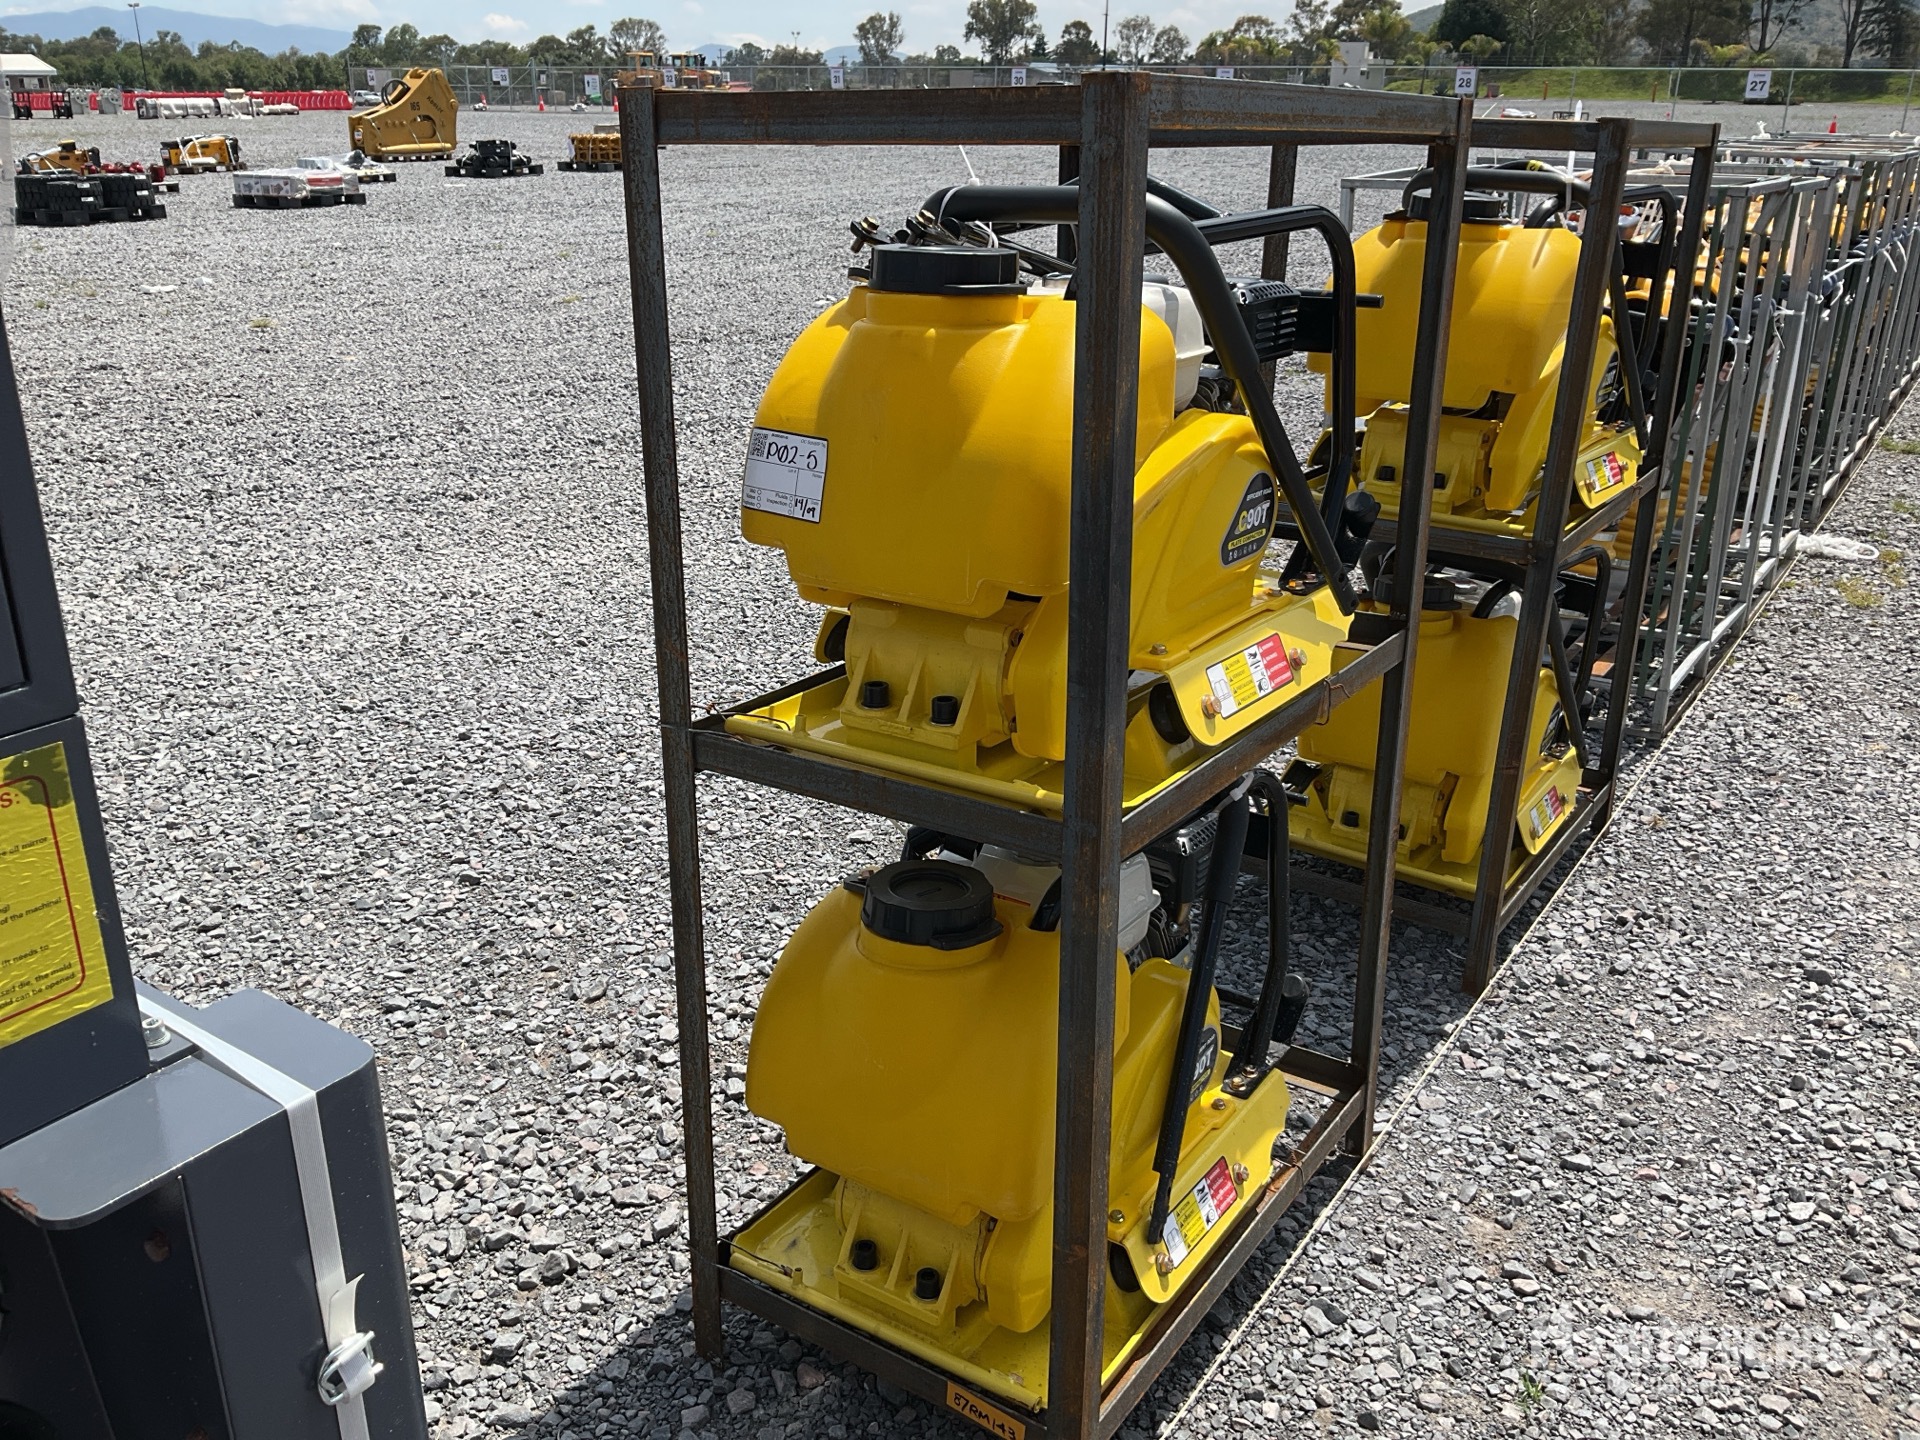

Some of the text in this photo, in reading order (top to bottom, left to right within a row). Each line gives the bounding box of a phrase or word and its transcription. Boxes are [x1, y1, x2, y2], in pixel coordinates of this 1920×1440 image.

[833, 75, 840, 83] 31
[1014, 76, 1023, 85] 30
[1458, 78, 1472, 88] 28
[1750, 81, 1766, 91] 27
[767, 498, 787, 506] Inspection
[1238, 502, 1270, 532] C90T
[1230, 538, 1242, 548] PLATE
[10, 912, 24, 921] the
[13, 948, 39, 963] needs
[40, 944, 49, 952] to
[35, 973, 50, 982] the
[15, 992, 31, 1002] can
[32, 987, 43, 996] be
[953, 1391, 1017, 1440] 87RM143
